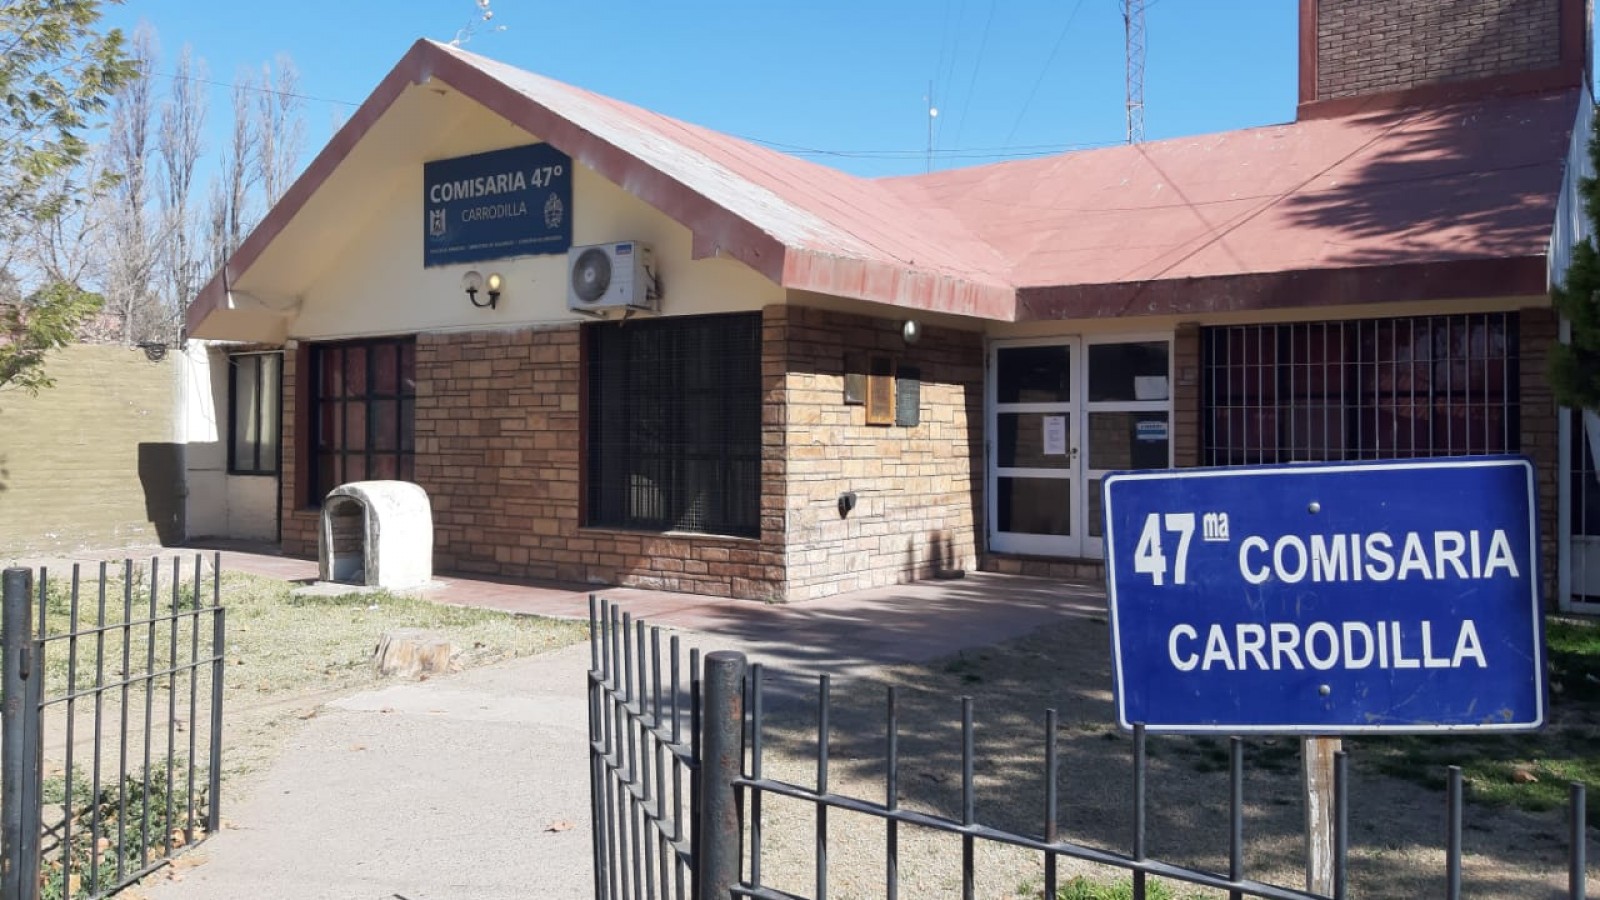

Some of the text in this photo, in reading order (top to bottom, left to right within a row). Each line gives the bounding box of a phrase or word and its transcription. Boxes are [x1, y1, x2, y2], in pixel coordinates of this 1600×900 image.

[430, 171, 526, 203] COMISARIA
[461, 201, 527, 222] CARRODILLA
[1239, 529, 1520, 584] COMISARIA
[1168, 619, 1488, 672] CARRODILLA
